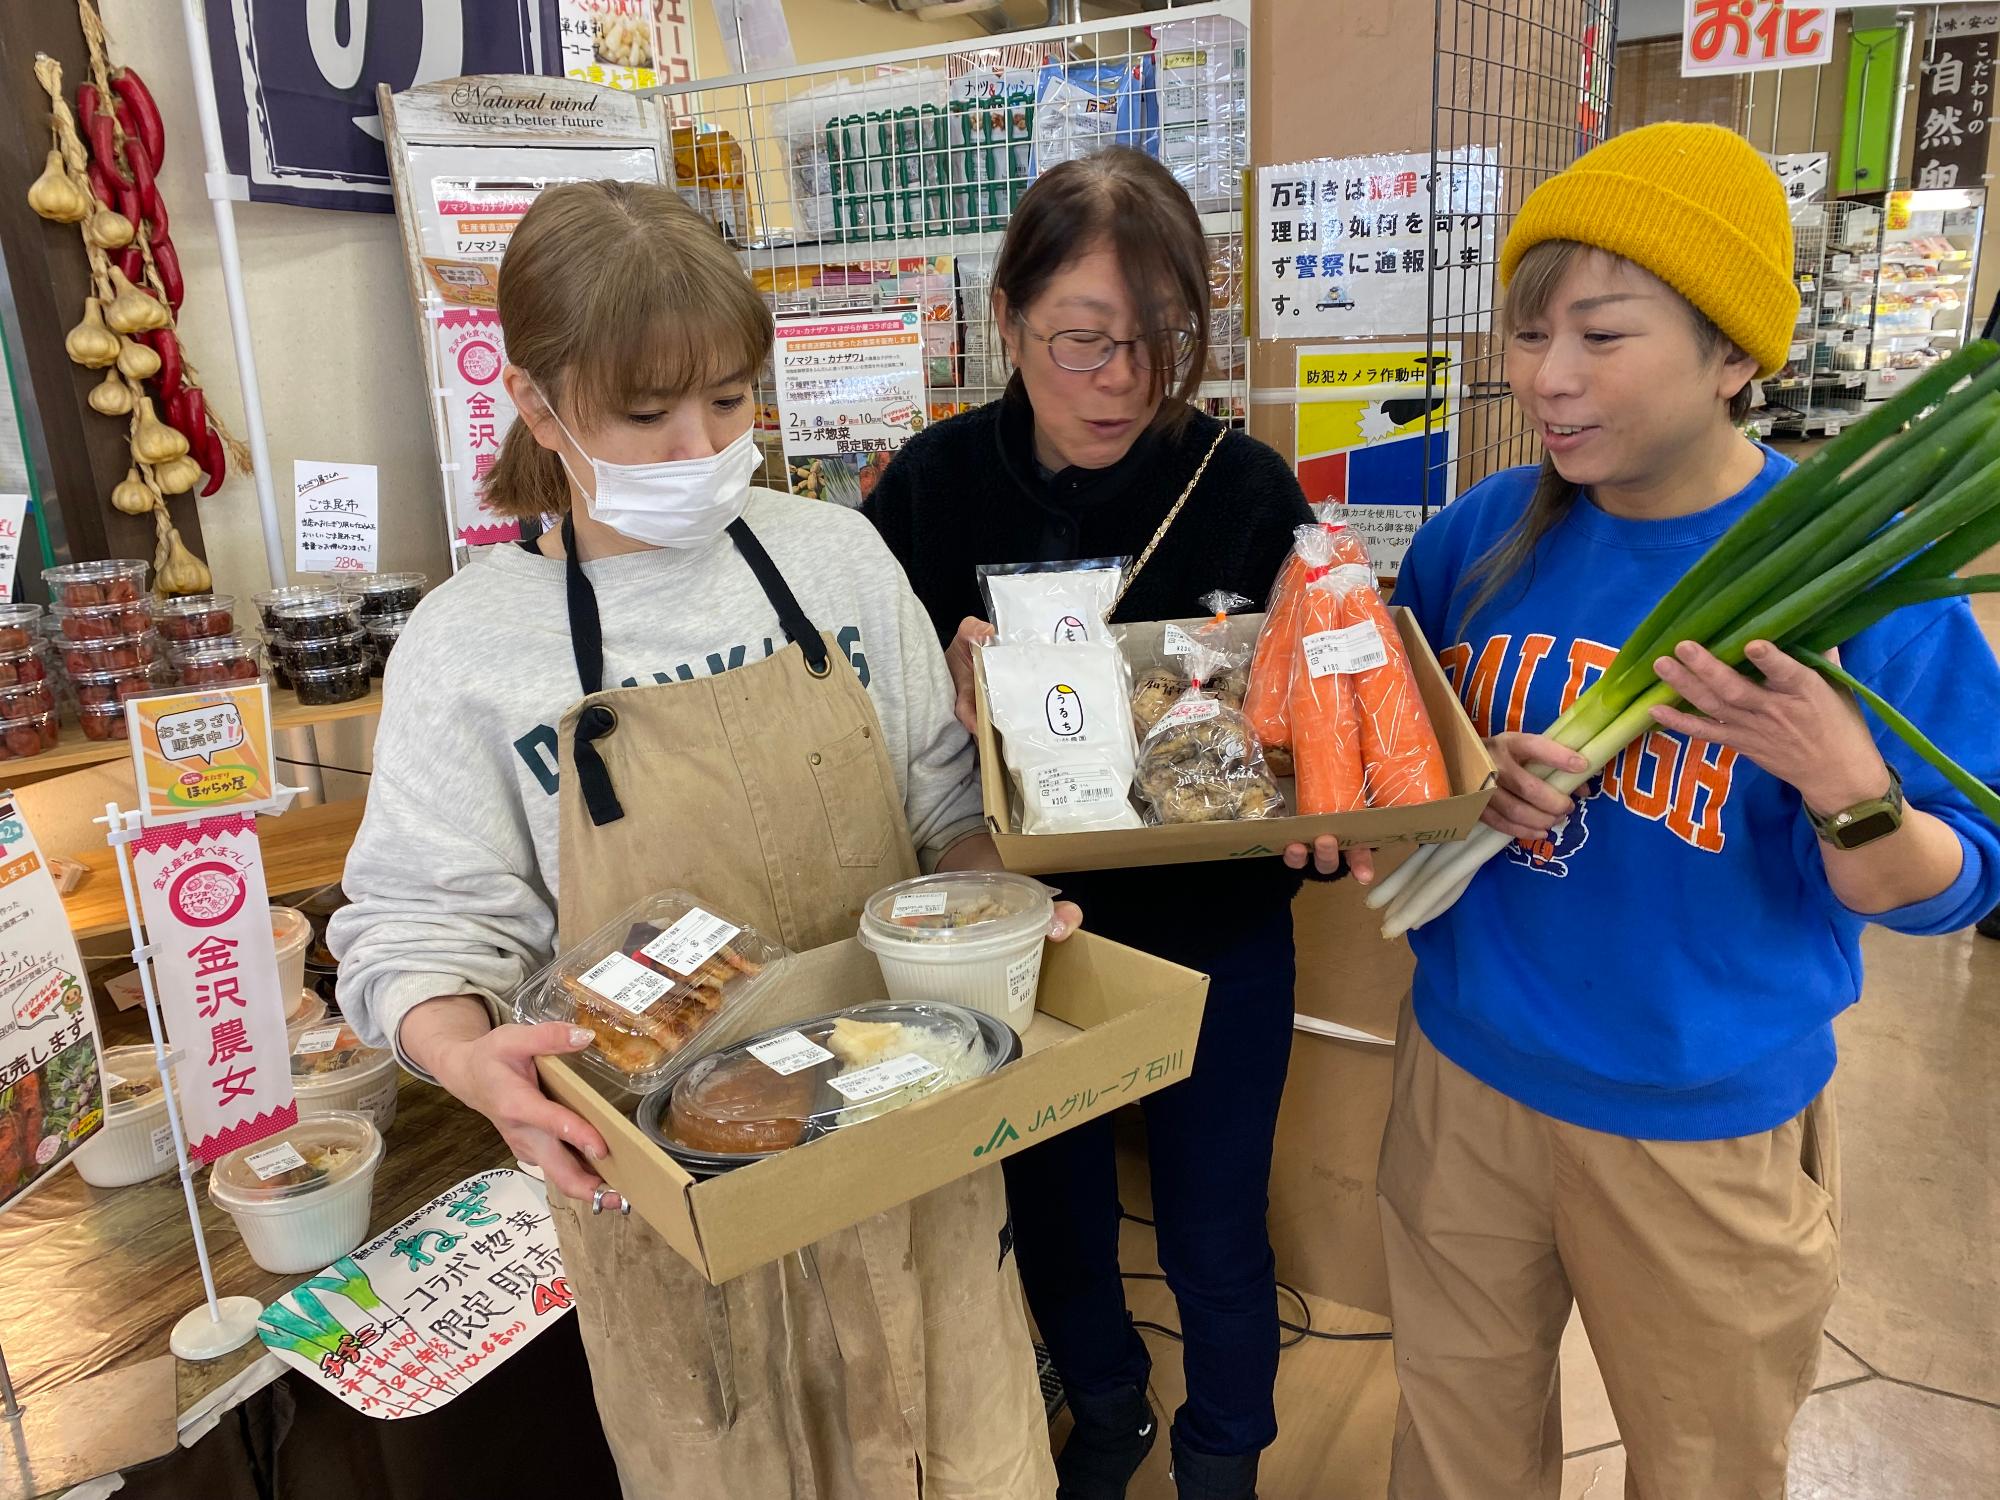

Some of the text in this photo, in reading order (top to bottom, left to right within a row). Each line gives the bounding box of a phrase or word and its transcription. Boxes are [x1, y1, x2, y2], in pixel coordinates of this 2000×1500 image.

[451, 83, 598, 111] Natural wind
[1968, 41, 1992, 135] こだわりの
[454, 112, 604, 127] Write a better future
[1918, 52, 1965, 190] 自然卵
[1271, 294, 1301, 317] す。
[1307, 367, 1425, 384] 防犯カメラ作動中
[789, 427, 850, 442] コラボ惣菜
[157, 711, 242, 740] おそうざい
[1056, 694, 1073, 732] うるち
[186, 775, 248, 799] ほがらか屋
[187, 935, 257, 1107] 金沢農女
[1028, 1049, 1184, 1133] JAグループ 石川
